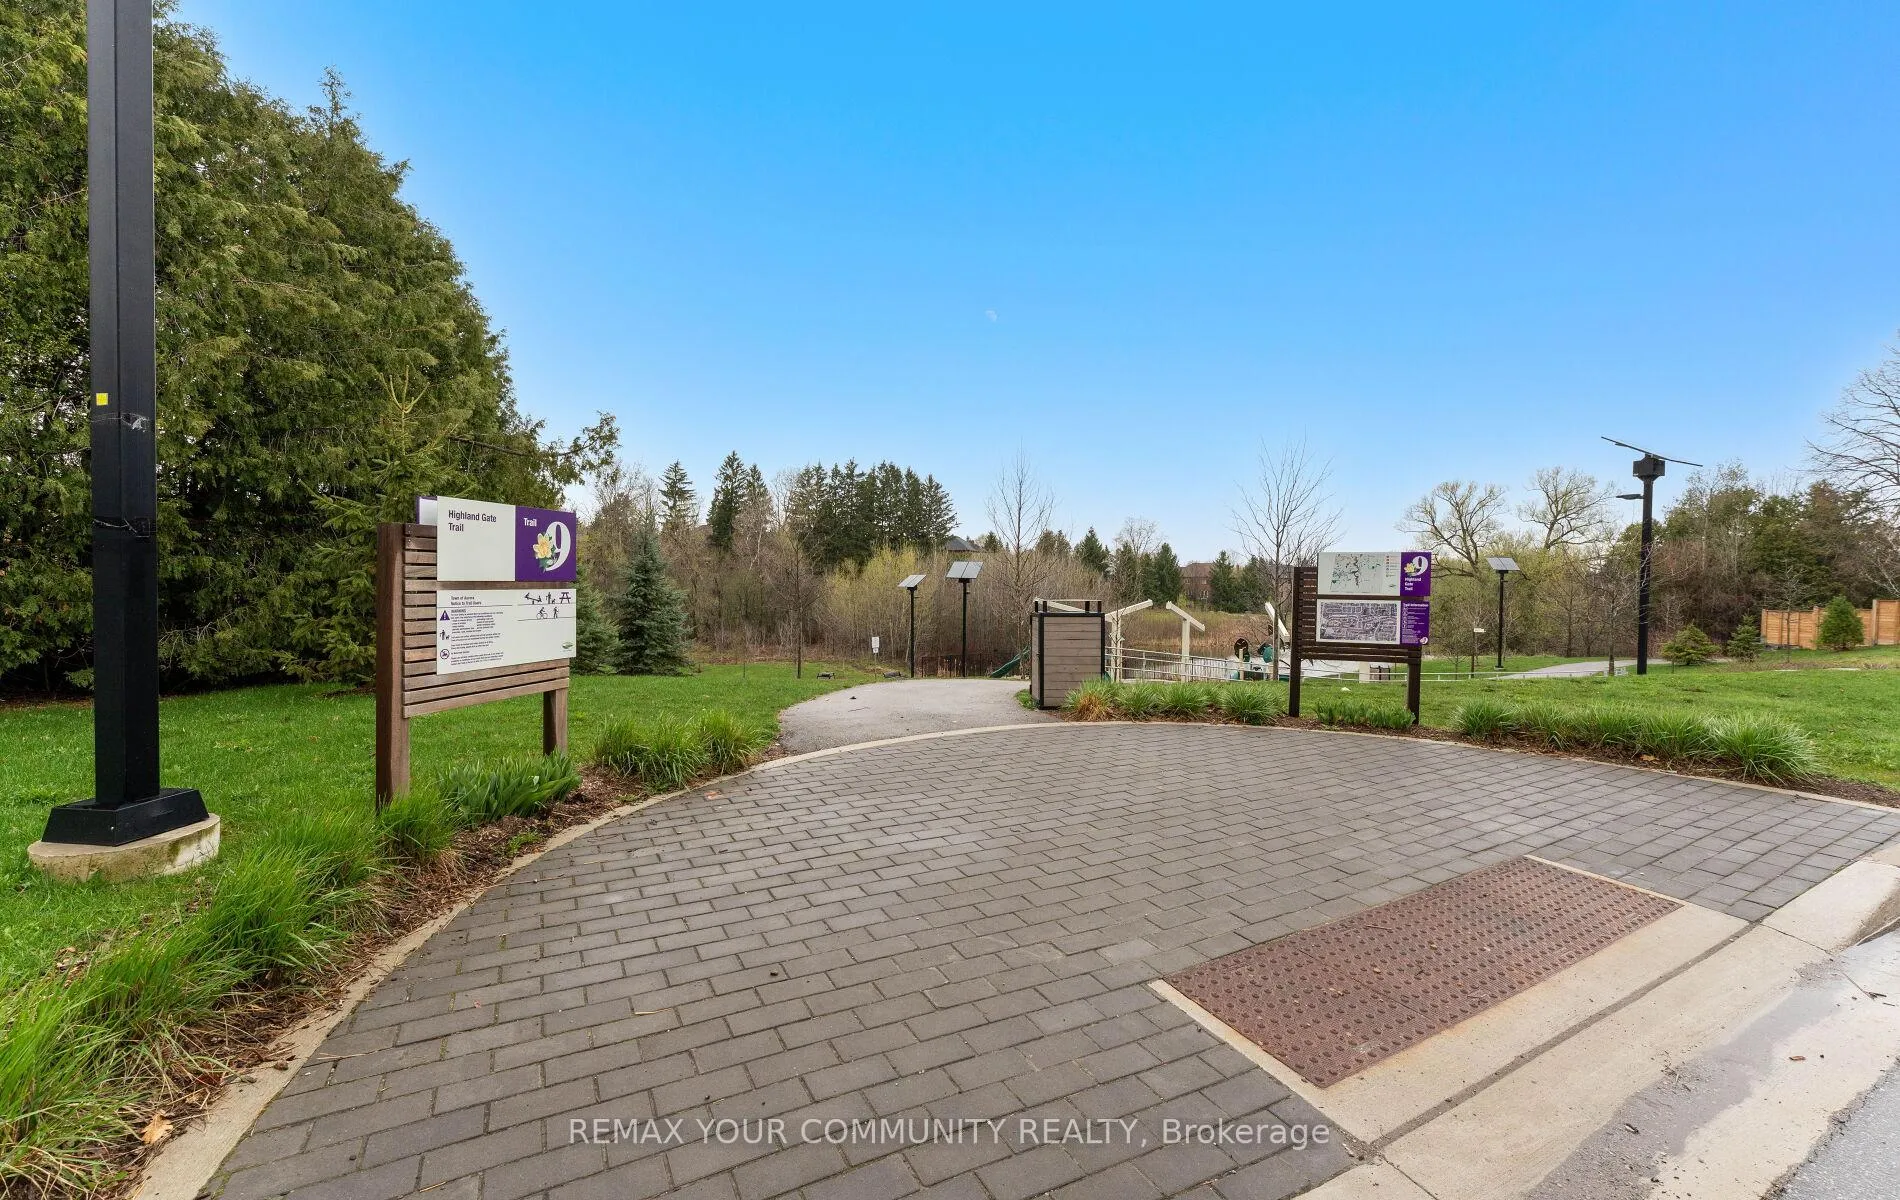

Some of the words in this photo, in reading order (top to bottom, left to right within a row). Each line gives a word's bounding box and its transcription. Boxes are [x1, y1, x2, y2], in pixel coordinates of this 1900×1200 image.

[448, 510, 480, 521] Highland
[481, 513, 497, 523] Gate
[523, 518, 538, 527] Trail
[448, 523, 464, 532] Trail
[544, 521, 571, 572] 9
[1411, 555, 1429, 577] 9
